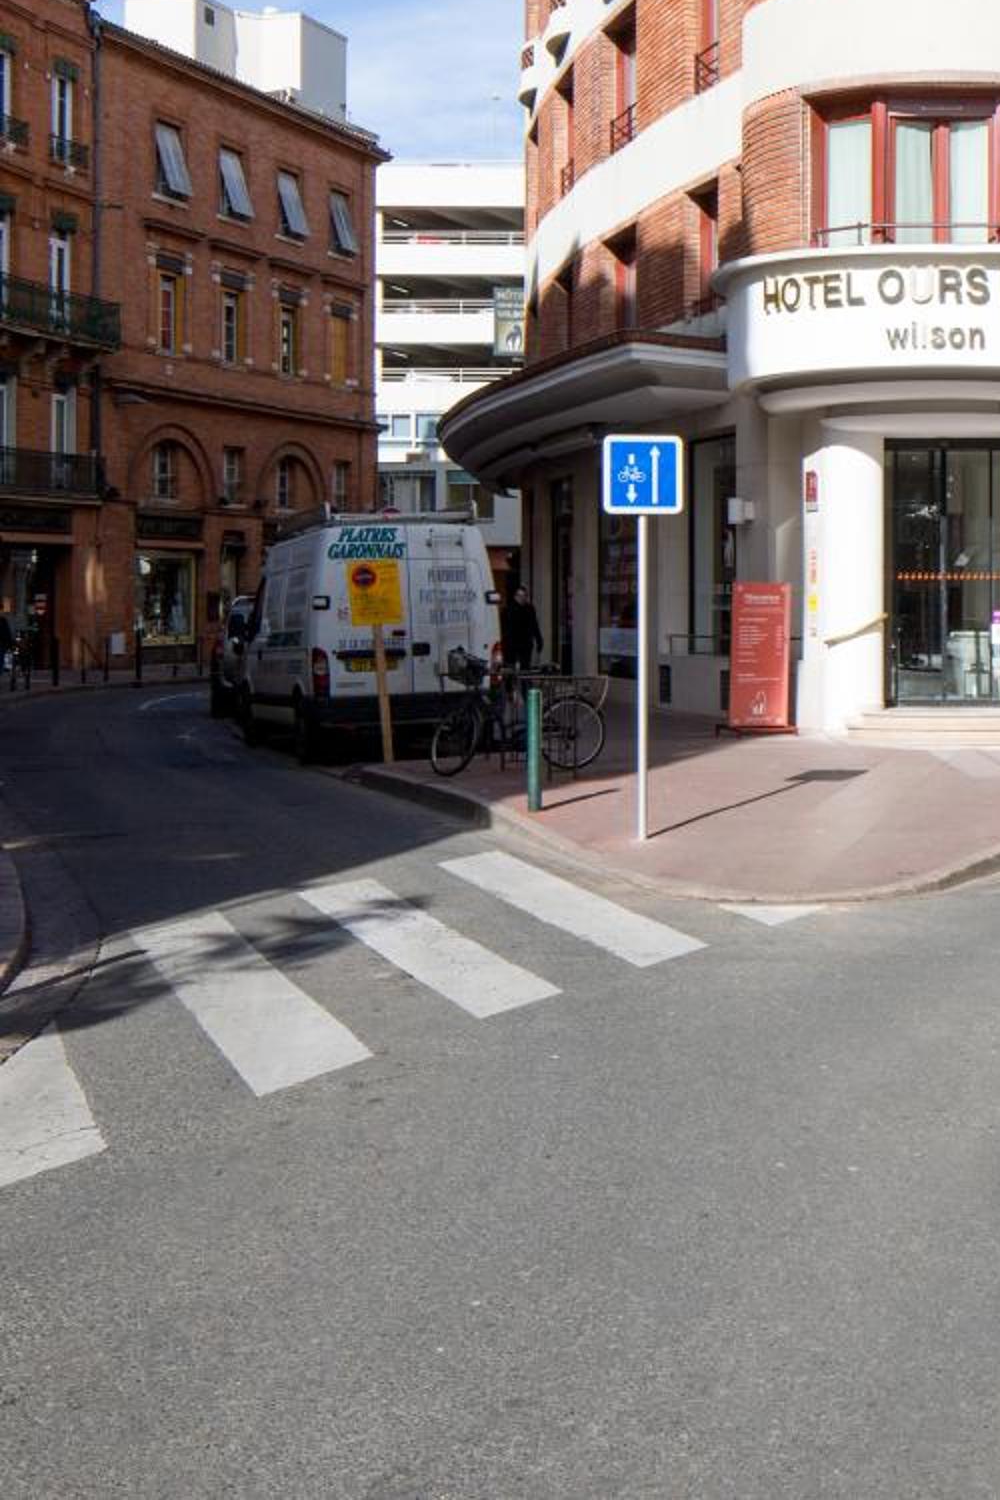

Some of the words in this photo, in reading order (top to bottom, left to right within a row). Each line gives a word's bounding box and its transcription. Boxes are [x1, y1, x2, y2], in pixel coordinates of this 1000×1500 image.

[762, 271, 865, 315] HOTEL
[877, 267, 992, 307] OURS
[886, 321, 987, 351] wilson
